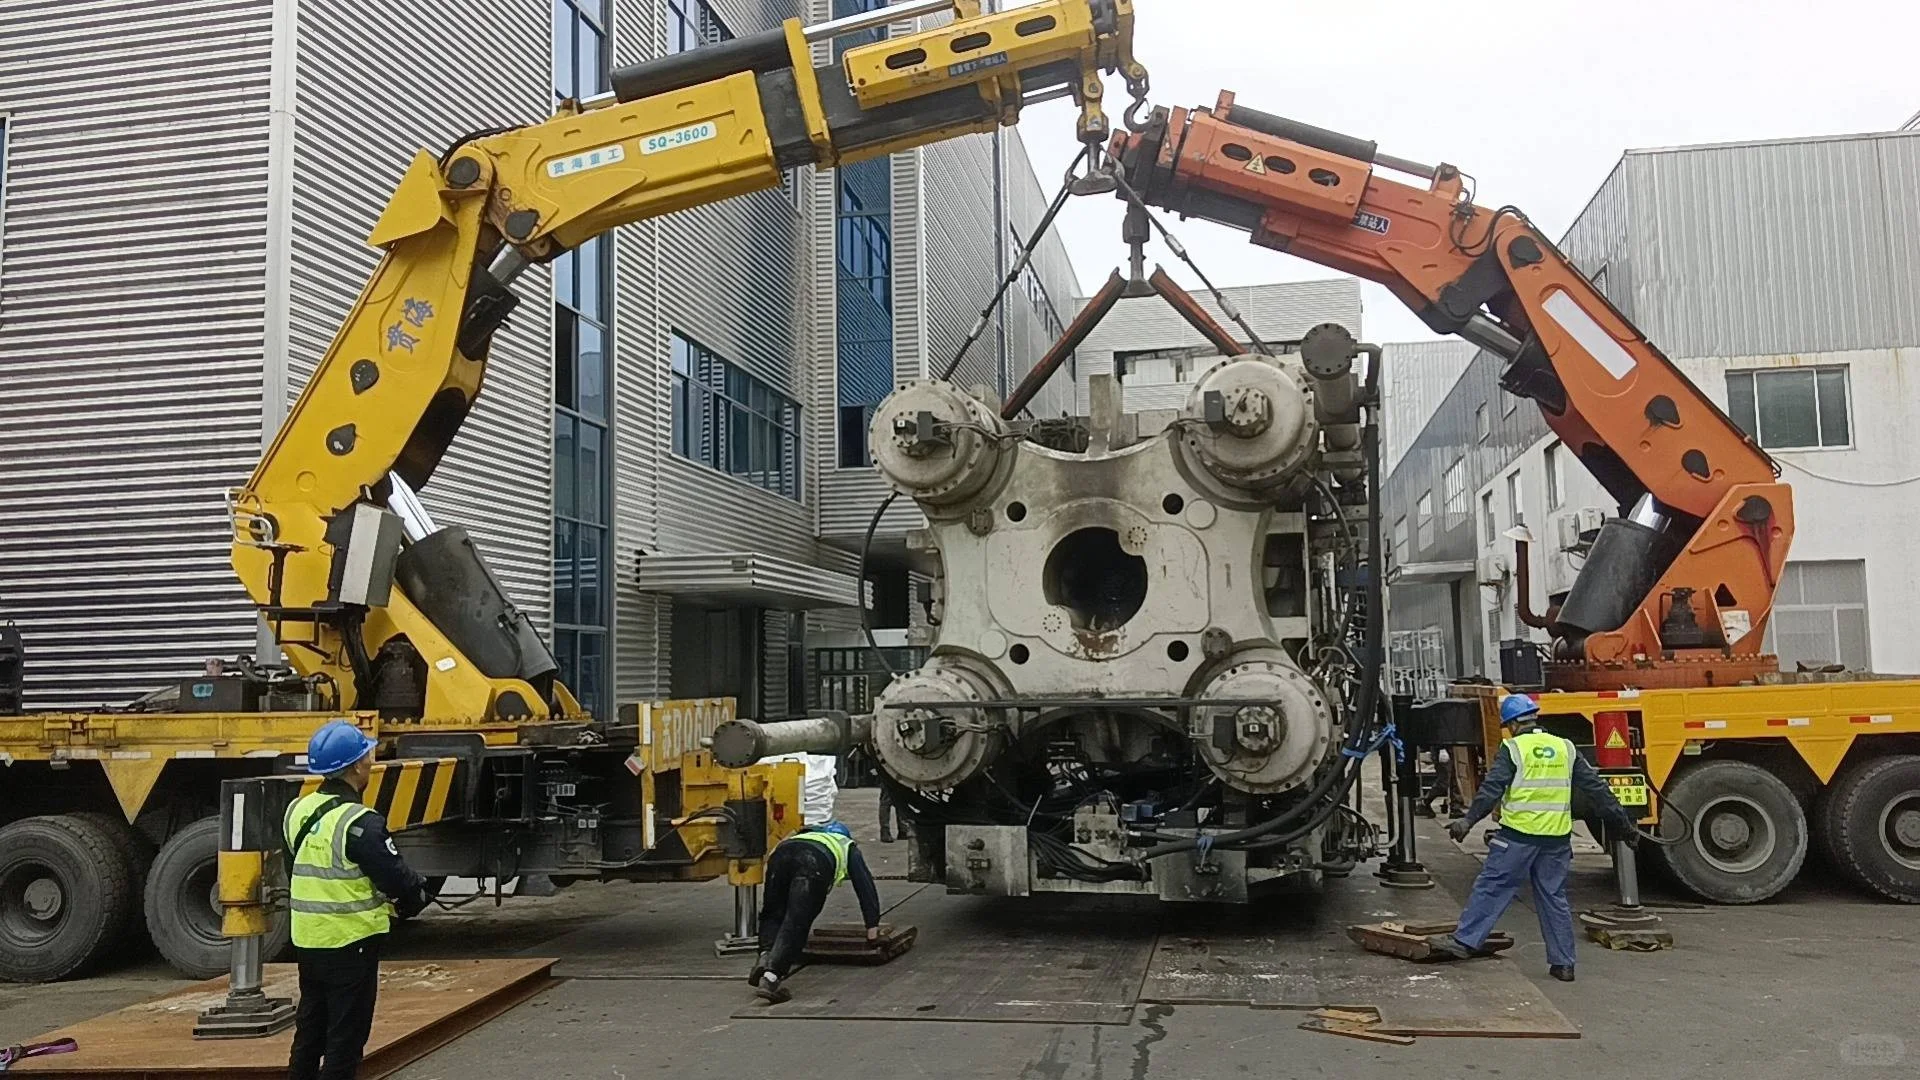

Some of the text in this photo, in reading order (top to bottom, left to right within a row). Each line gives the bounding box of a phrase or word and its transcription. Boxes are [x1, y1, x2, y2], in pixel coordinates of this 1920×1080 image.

[648, 125, 708, 150] SQ-3600
[1356, 213, 1387, 232] 禁站人
